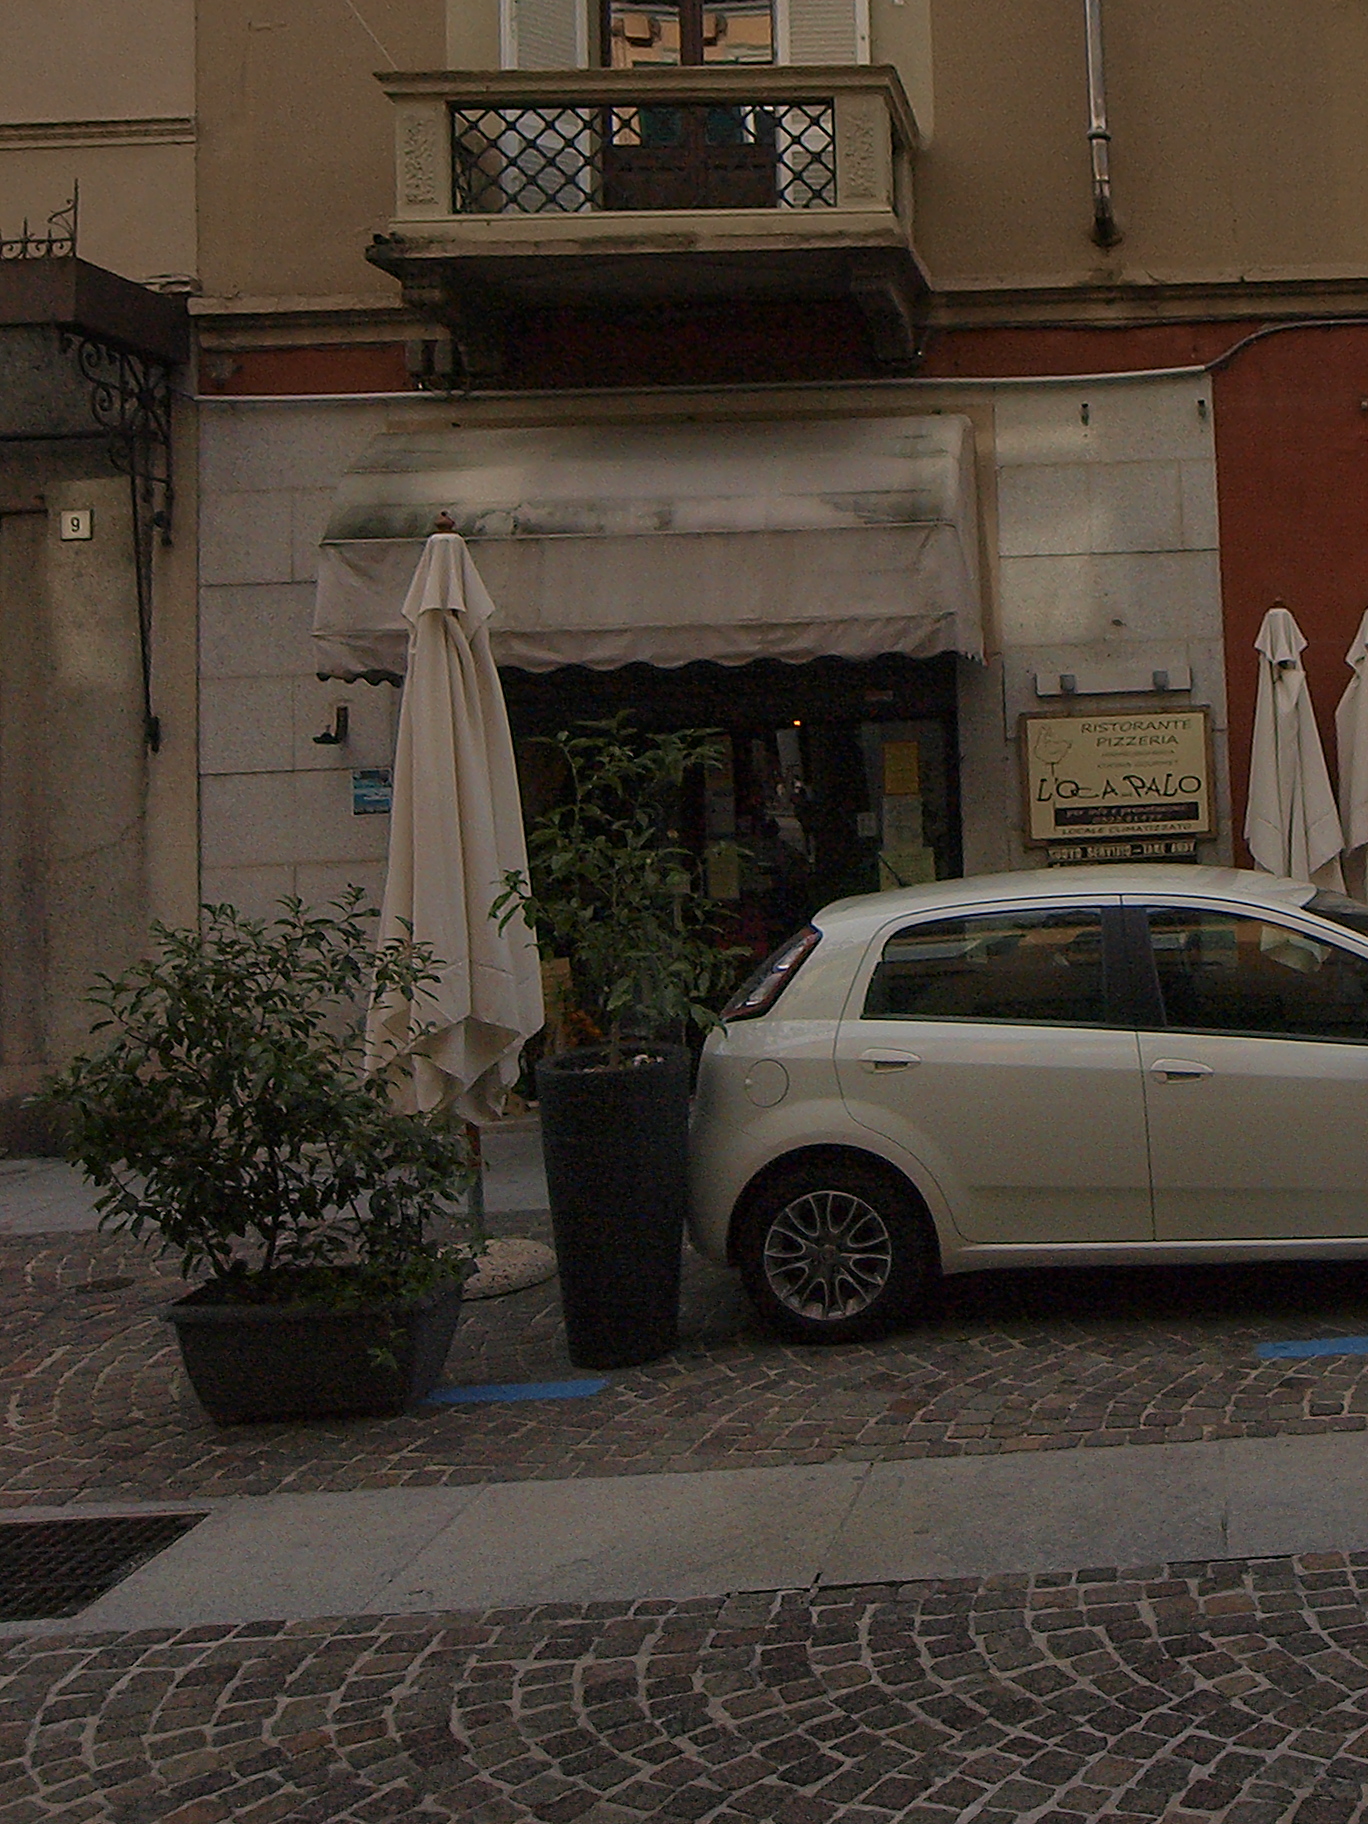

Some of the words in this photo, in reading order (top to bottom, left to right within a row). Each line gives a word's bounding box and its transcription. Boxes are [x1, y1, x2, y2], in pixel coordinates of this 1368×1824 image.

[70, 516, 80, 533] 9
[1080, 719, 1191, 735] RISTORANTE
[1095, 734, 1179, 748] PIZZERIA
[1062, 826, 1105, 836] LOCALE
[1109, 822, 1193, 834] CLIMATIZZATO
